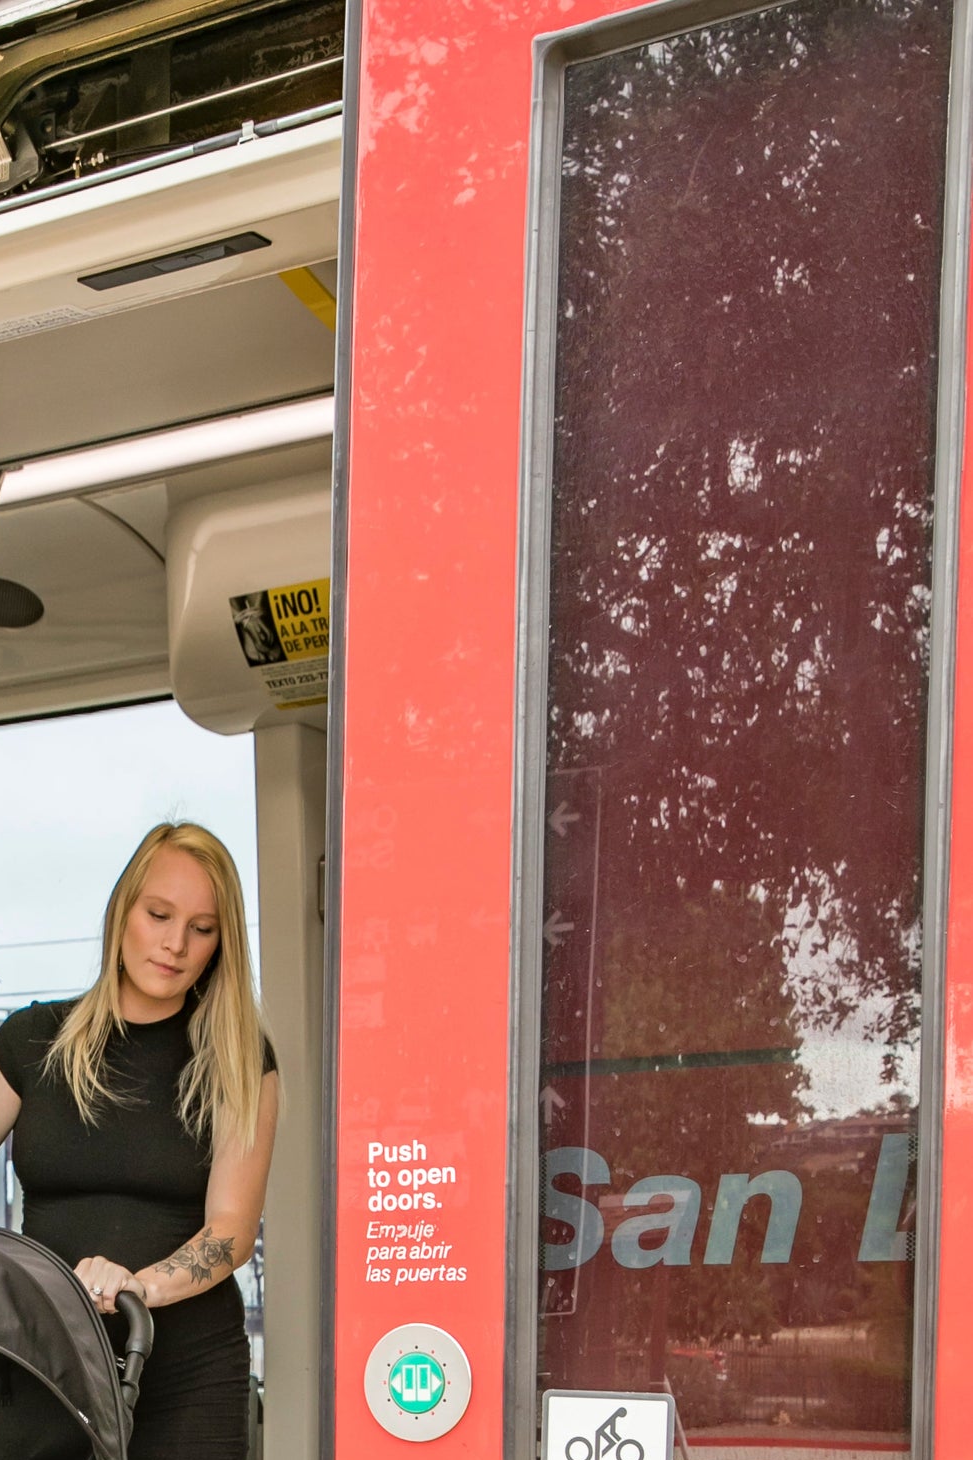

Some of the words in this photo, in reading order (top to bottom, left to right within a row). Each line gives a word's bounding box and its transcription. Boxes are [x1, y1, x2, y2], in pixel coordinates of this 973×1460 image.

[274, 588, 322, 620] ¡NO!
[280, 625, 290, 638] A
[291, 621, 309, 636] LA
[284, 639, 304, 654] DE
[306, 634, 329, 650] PER
[266, 674, 296, 689] TEXTO
[368, 1140, 427, 1164] Push
[367, 1168, 390, 1188] to
[398, 1166, 456, 1190] open
[368, 1190, 442, 1212] doors.
[538, 1146, 802, 1270] San
[366, 1220, 435, 1242] Empuje
[366, 1245, 406, 1264] para
[409, 1241, 452, 1260] abrir
[366, 1264, 391, 1282] las
[394, 1264, 468, 1286] puertas
